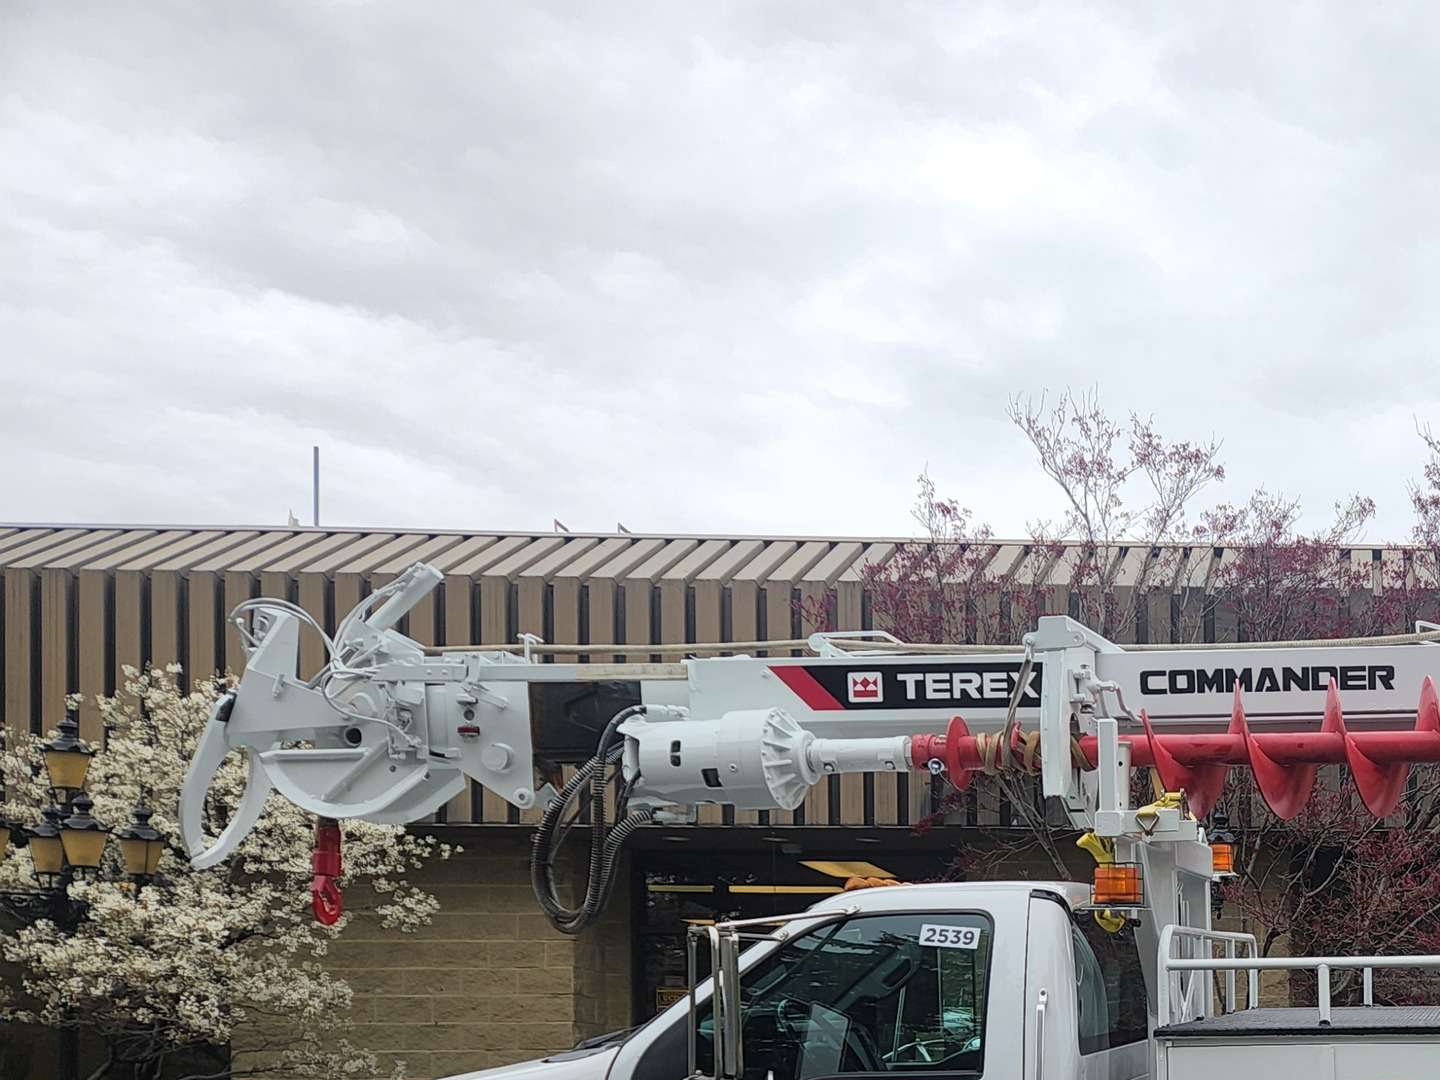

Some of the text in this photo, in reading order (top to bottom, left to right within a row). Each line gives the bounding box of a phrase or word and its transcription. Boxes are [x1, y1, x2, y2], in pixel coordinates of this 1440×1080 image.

[896, 671, 1040, 700] TEREX
[1140, 665, 1395, 695] COMMANDER
[923, 927, 975, 946] 2539
